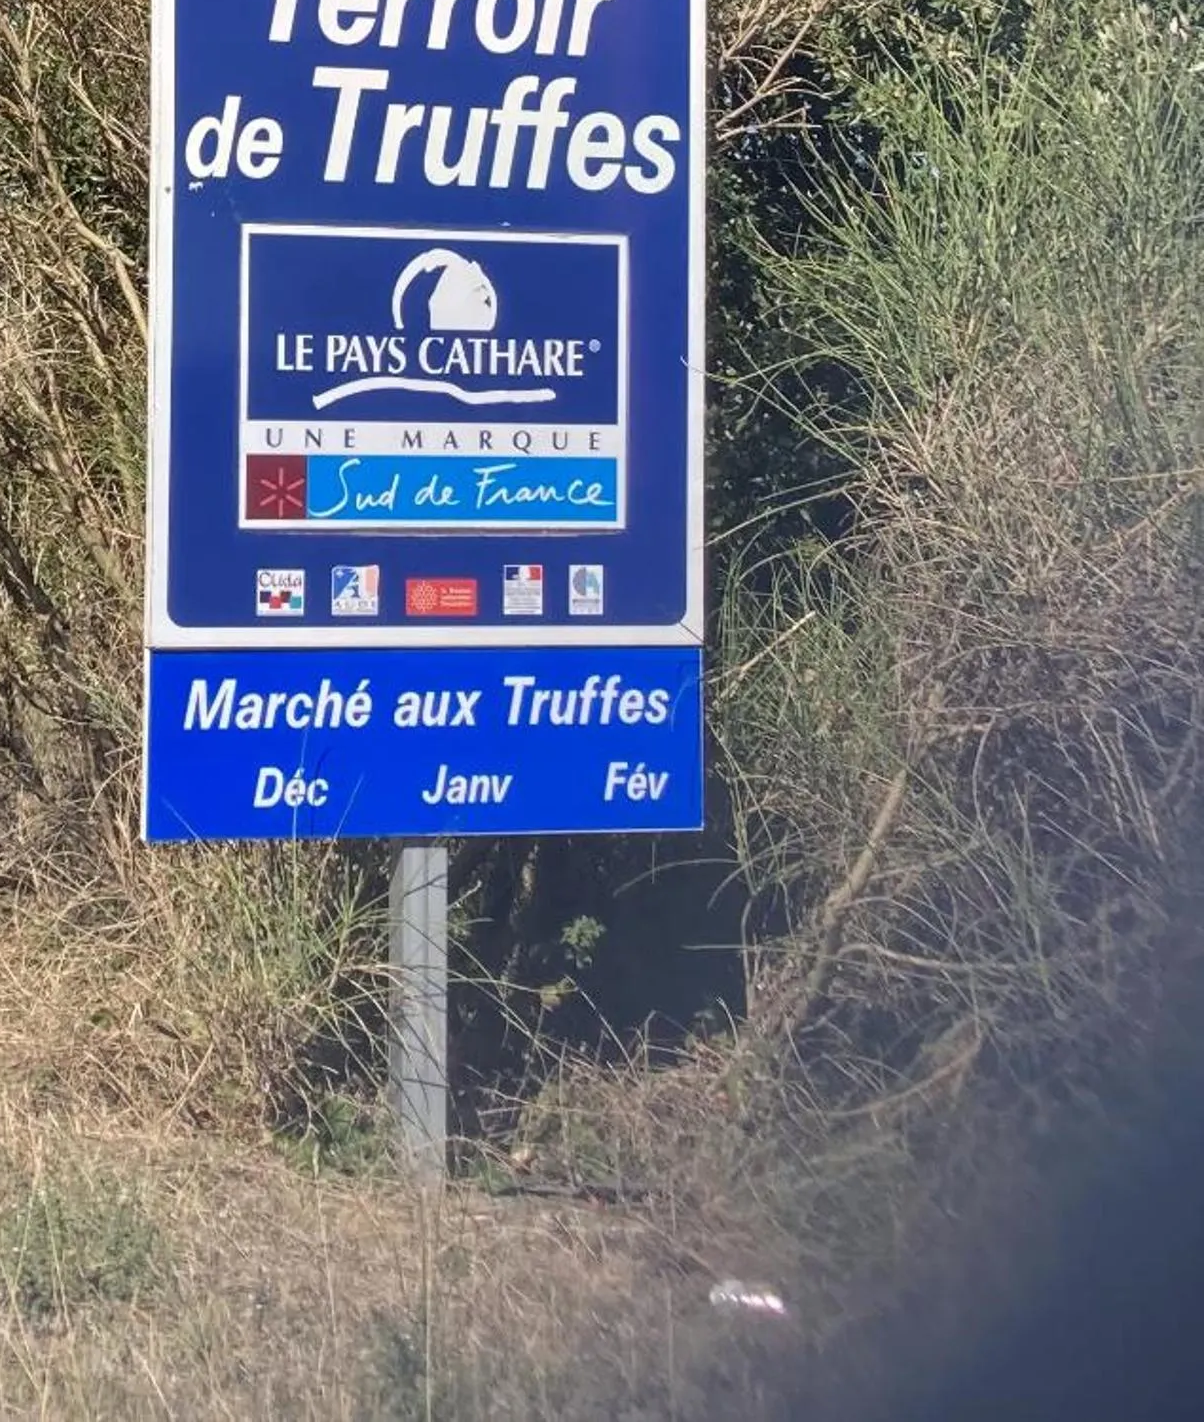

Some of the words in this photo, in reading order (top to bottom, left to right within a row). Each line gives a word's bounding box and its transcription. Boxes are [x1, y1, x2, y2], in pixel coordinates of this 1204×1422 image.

[185, 96, 284, 179] de
[312, 66, 681, 194] Truffes
[276, 334, 313, 371] LE
[326, 335, 407, 375] PAYS
[266, 428, 356, 449] UNE
[401, 431, 600, 454] MARQUE
[307, 459, 399, 518] Sud
[415, 477, 460, 506] de
[473, 463, 614, 509] France
[183, 678, 372, 730] Marché
[393, 690, 481, 727] aux
[503, 675, 669, 725] Truffes
[253, 766, 329, 808] Déc
[422, 765, 513, 805] Janv
[603, 761, 669, 802] Fév
